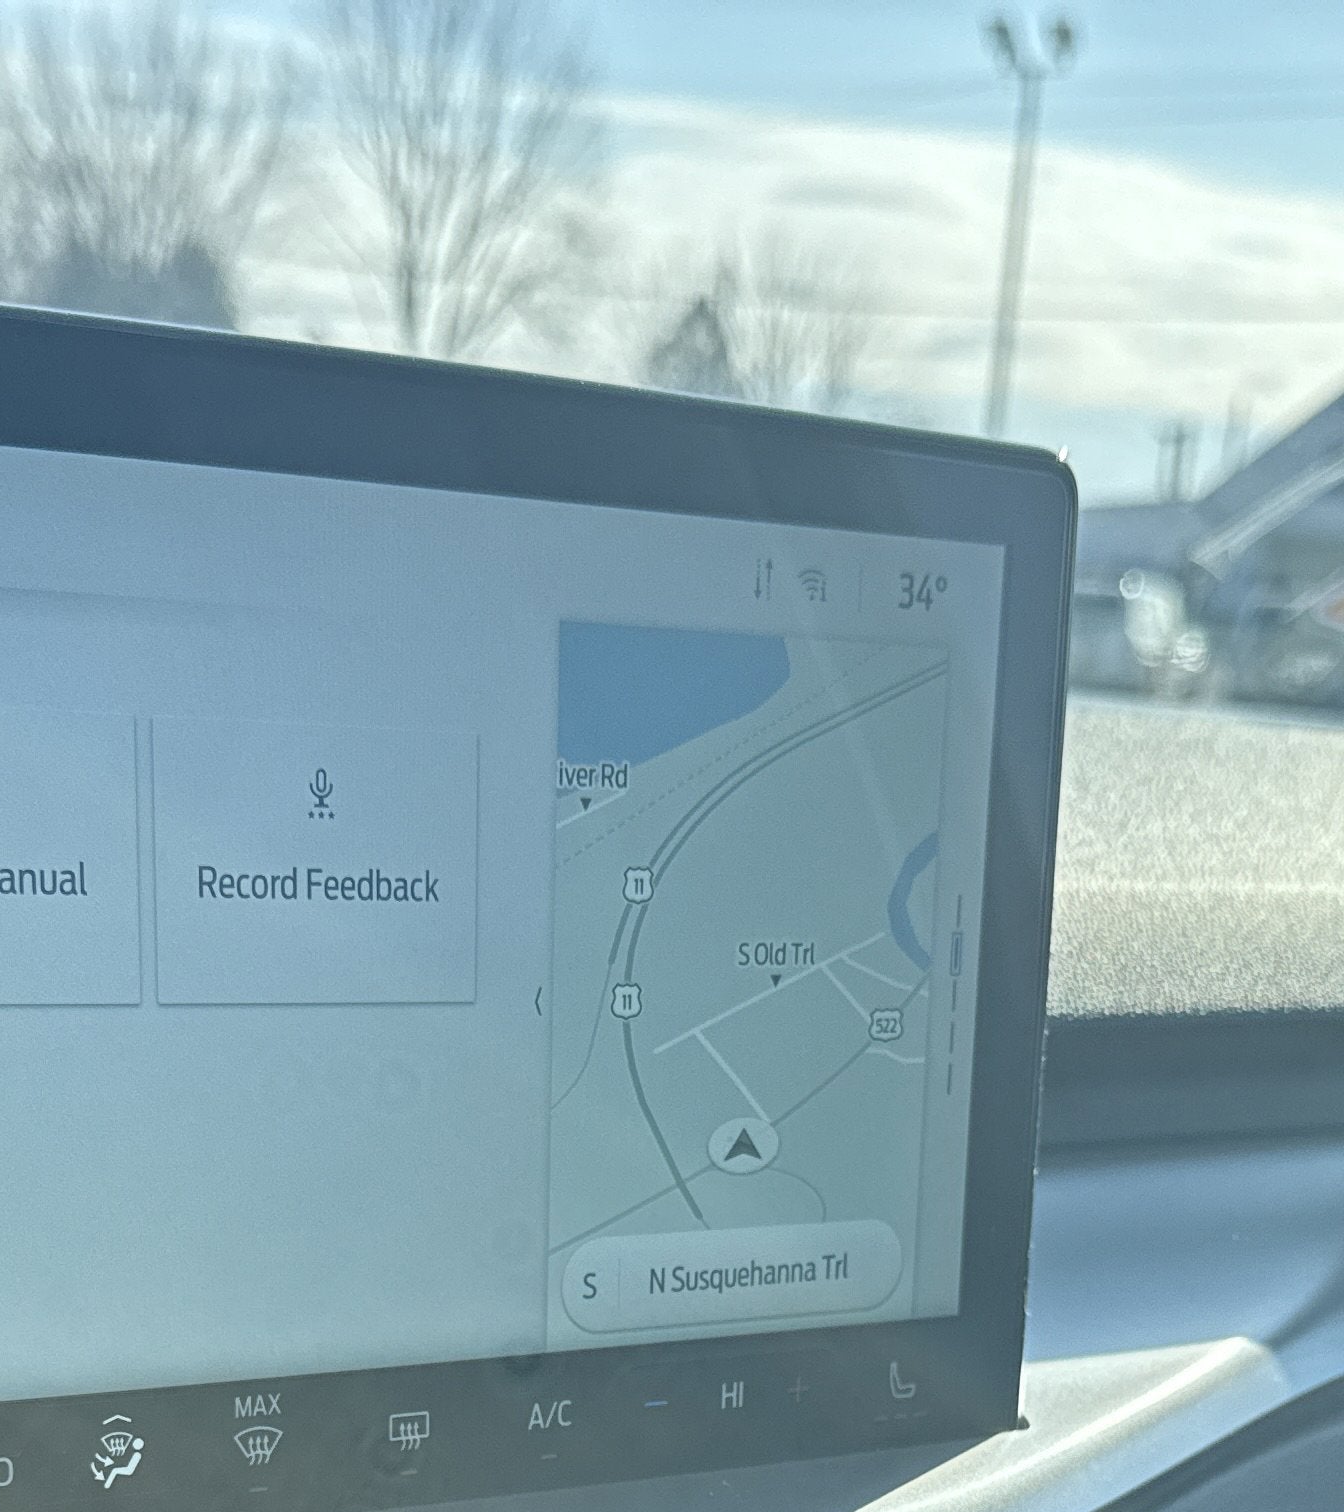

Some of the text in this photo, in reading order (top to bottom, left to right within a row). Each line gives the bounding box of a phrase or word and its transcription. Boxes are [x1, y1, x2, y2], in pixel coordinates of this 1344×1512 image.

[899, 571, 949, 611] 34°
[558, 761, 628, 789] iver Rd
[197, 866, 439, 903] Record Feedback
[633, 877, 645, 895] 11
[738, 942, 815, 966] S Old Trl
[622, 994, 633, 1011] 11
[875, 1017, 897, 1035] 522
[582, 1273, 597, 1299] S
[649, 1253, 848, 1297] N Susquehanna Trl
[235, 1394, 281, 1419] MAX
[721, 1381, 744, 1409] HI
[528, 1400, 572, 1430] A/C
